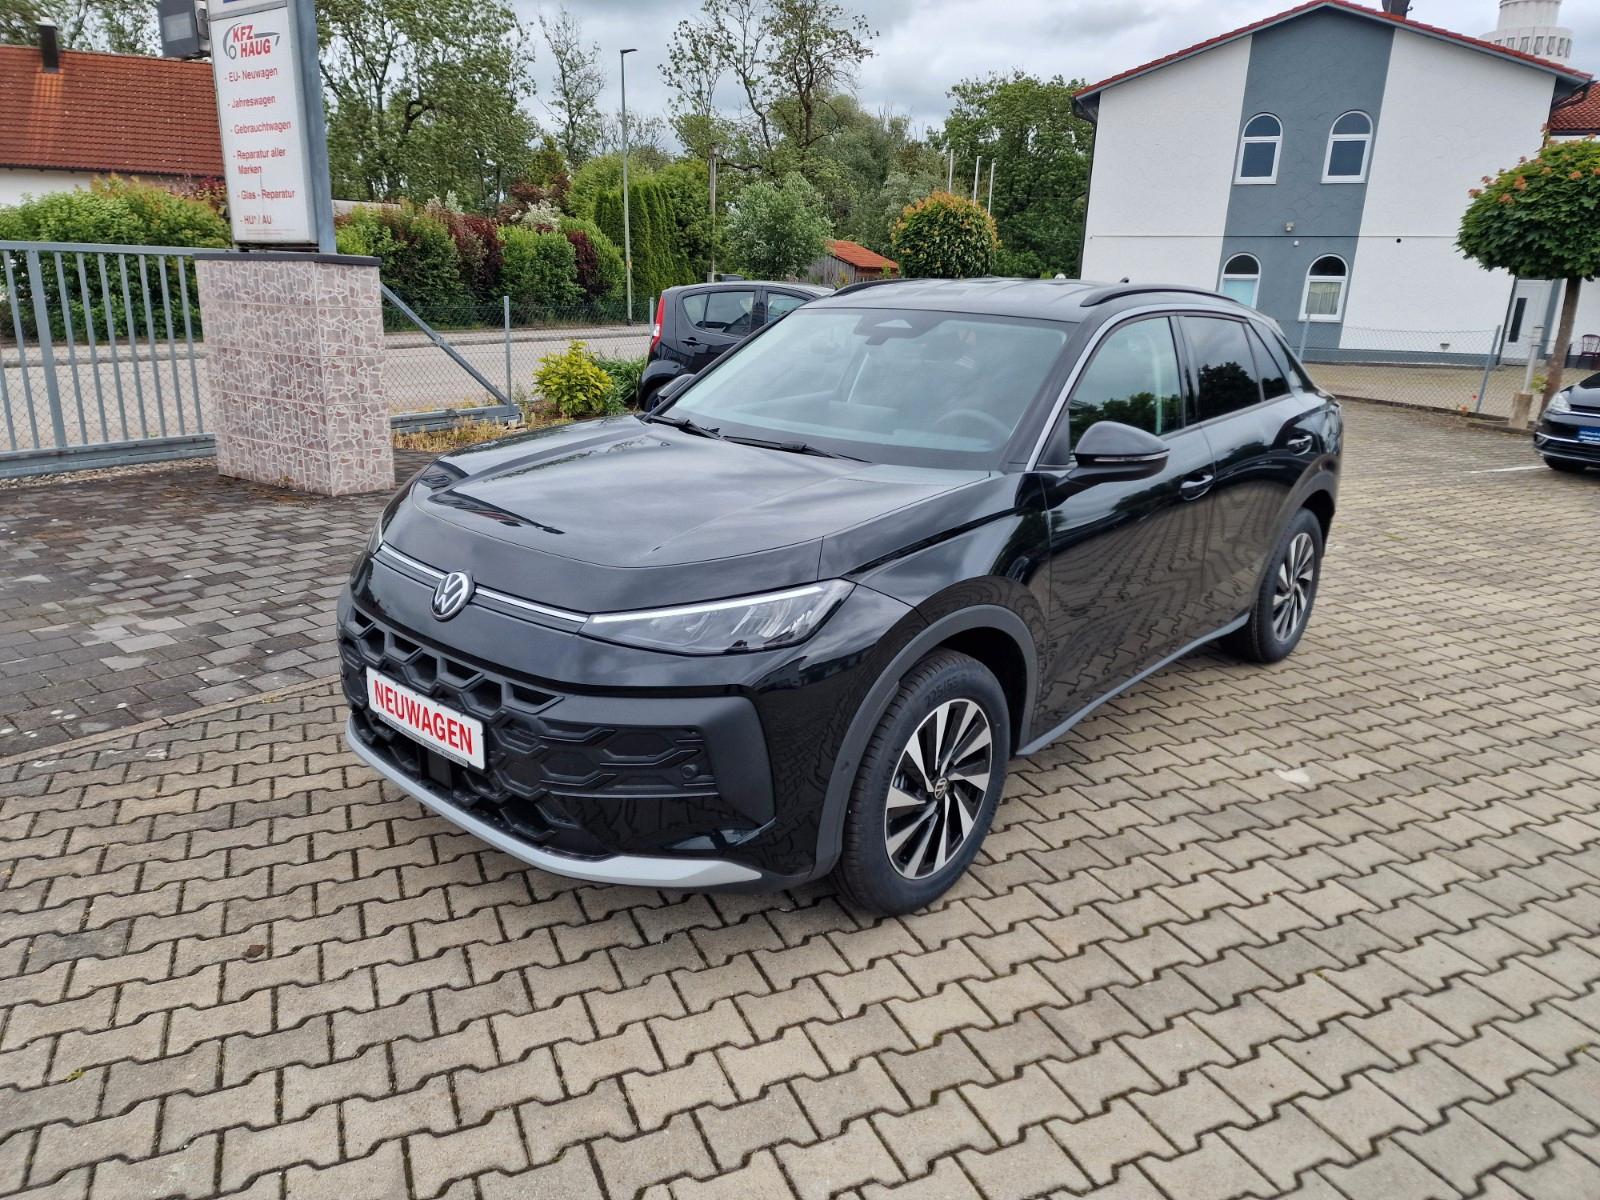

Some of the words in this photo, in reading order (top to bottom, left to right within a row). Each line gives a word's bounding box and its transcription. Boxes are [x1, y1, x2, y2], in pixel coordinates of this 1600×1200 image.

[232, 25, 253, 42] KFZ
[240, 38, 271, 58] HAUG
[242, 67, 278, 80] Neuwagen
[231, 95, 276, 109] Jahreswagen
[234, 121, 292, 135] Gebrauchtwagen
[237, 149, 269, 161] Reparatur
[270, 147, 286, 157] aller
[238, 165, 262, 175] Marken
[241, 190, 257, 200] Glas
[261, 189, 295, 201] Reparatur
[262, 214, 272, 225] AU
[374, 679, 473, 755] NEUWAGEN
